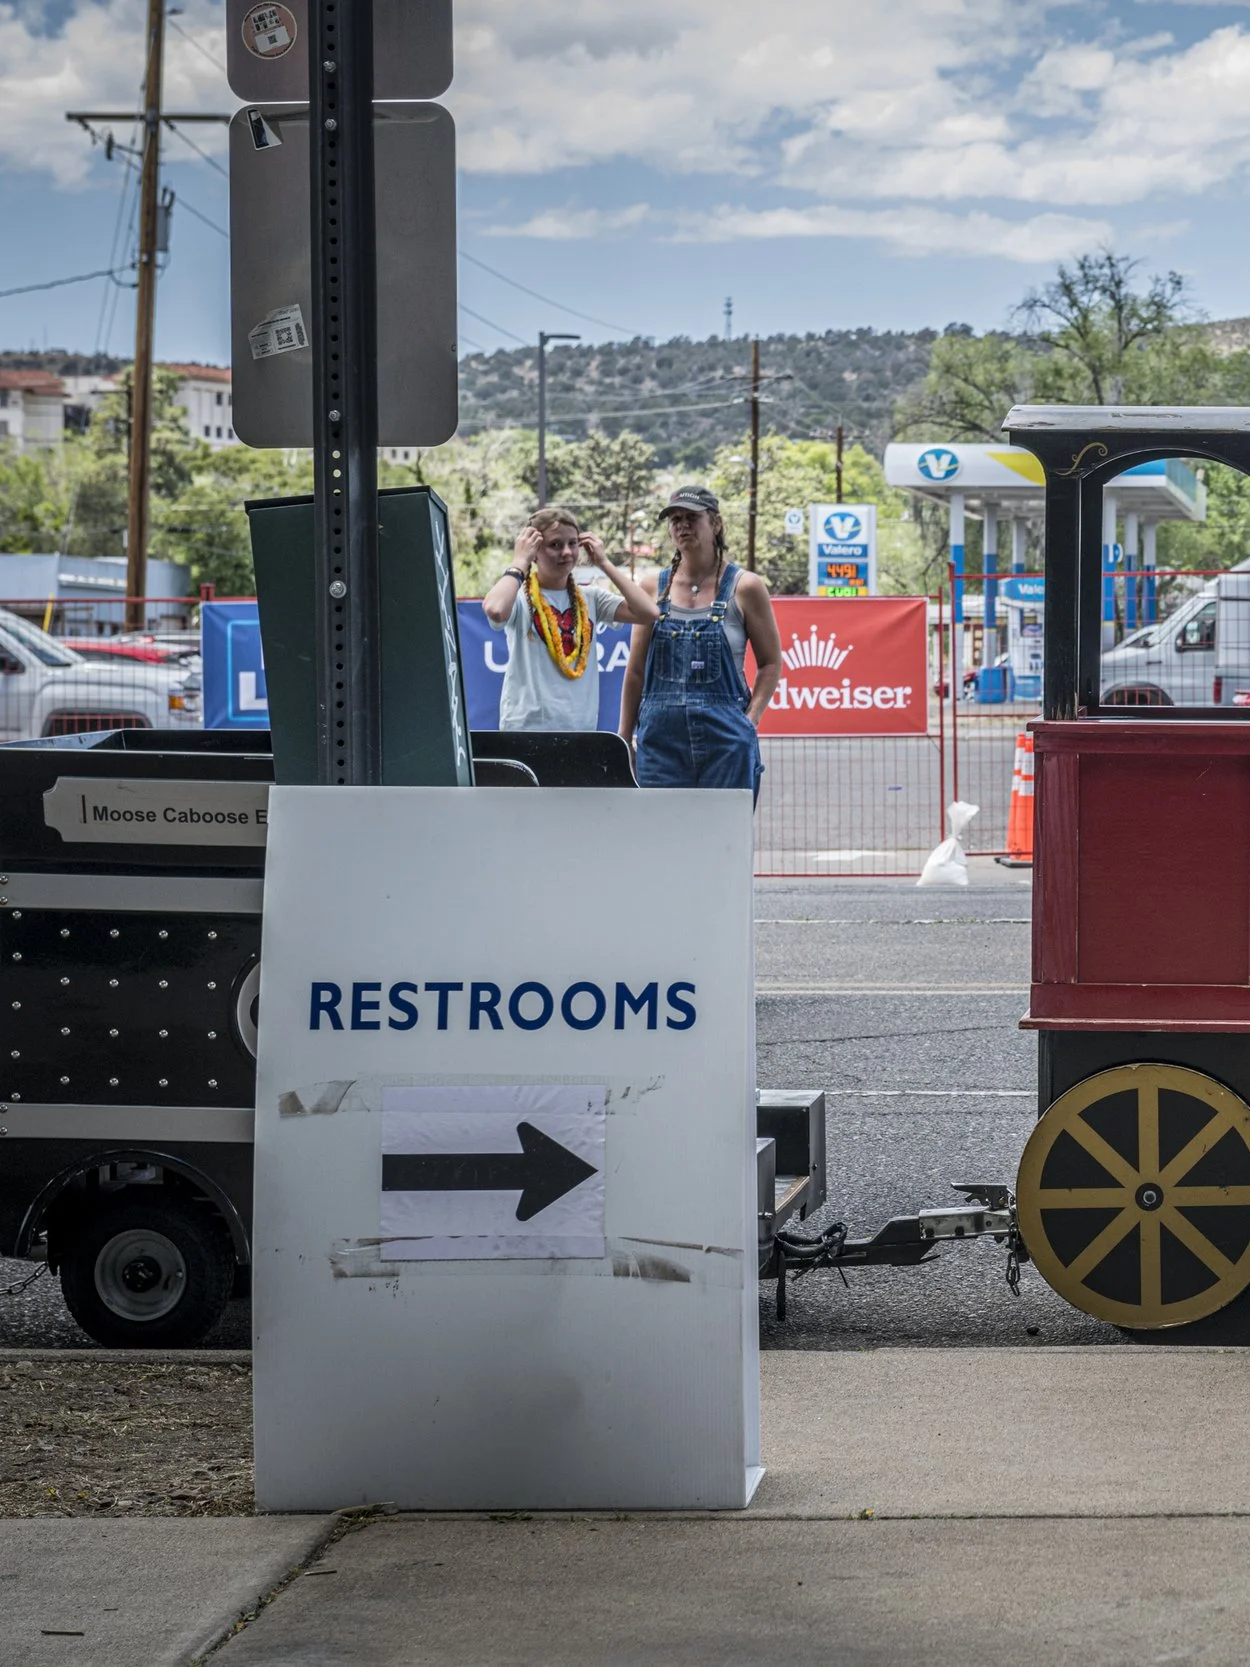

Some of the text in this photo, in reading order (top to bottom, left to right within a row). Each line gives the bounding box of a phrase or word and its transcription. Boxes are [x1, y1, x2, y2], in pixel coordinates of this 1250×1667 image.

[822, 544, 863, 556] Valero
[1017, 583, 1045, 595] Vale
[767, 677, 913, 710] dweiser
[92, 805, 157, 823] Moose
[162, 807, 249, 825] Caboose
[308, 980, 698, 1032] RESTROOMS
